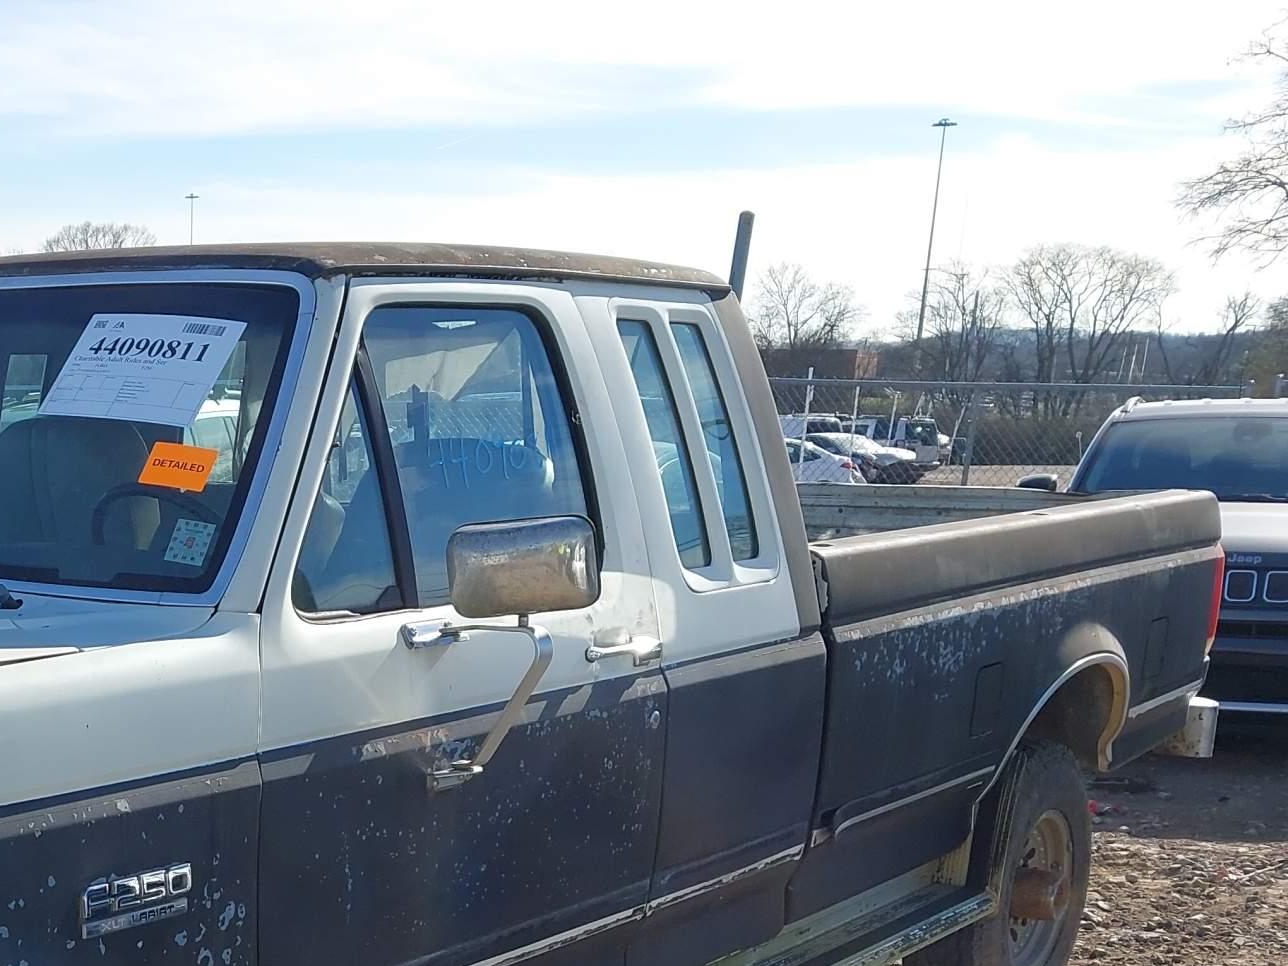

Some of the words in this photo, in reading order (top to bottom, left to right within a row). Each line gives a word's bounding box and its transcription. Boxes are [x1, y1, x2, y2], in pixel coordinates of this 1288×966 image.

[88, 336, 210, 362] 44090811
[152, 458, 205, 473] DETAILED
[1227, 554, 1262, 564] Jeep
